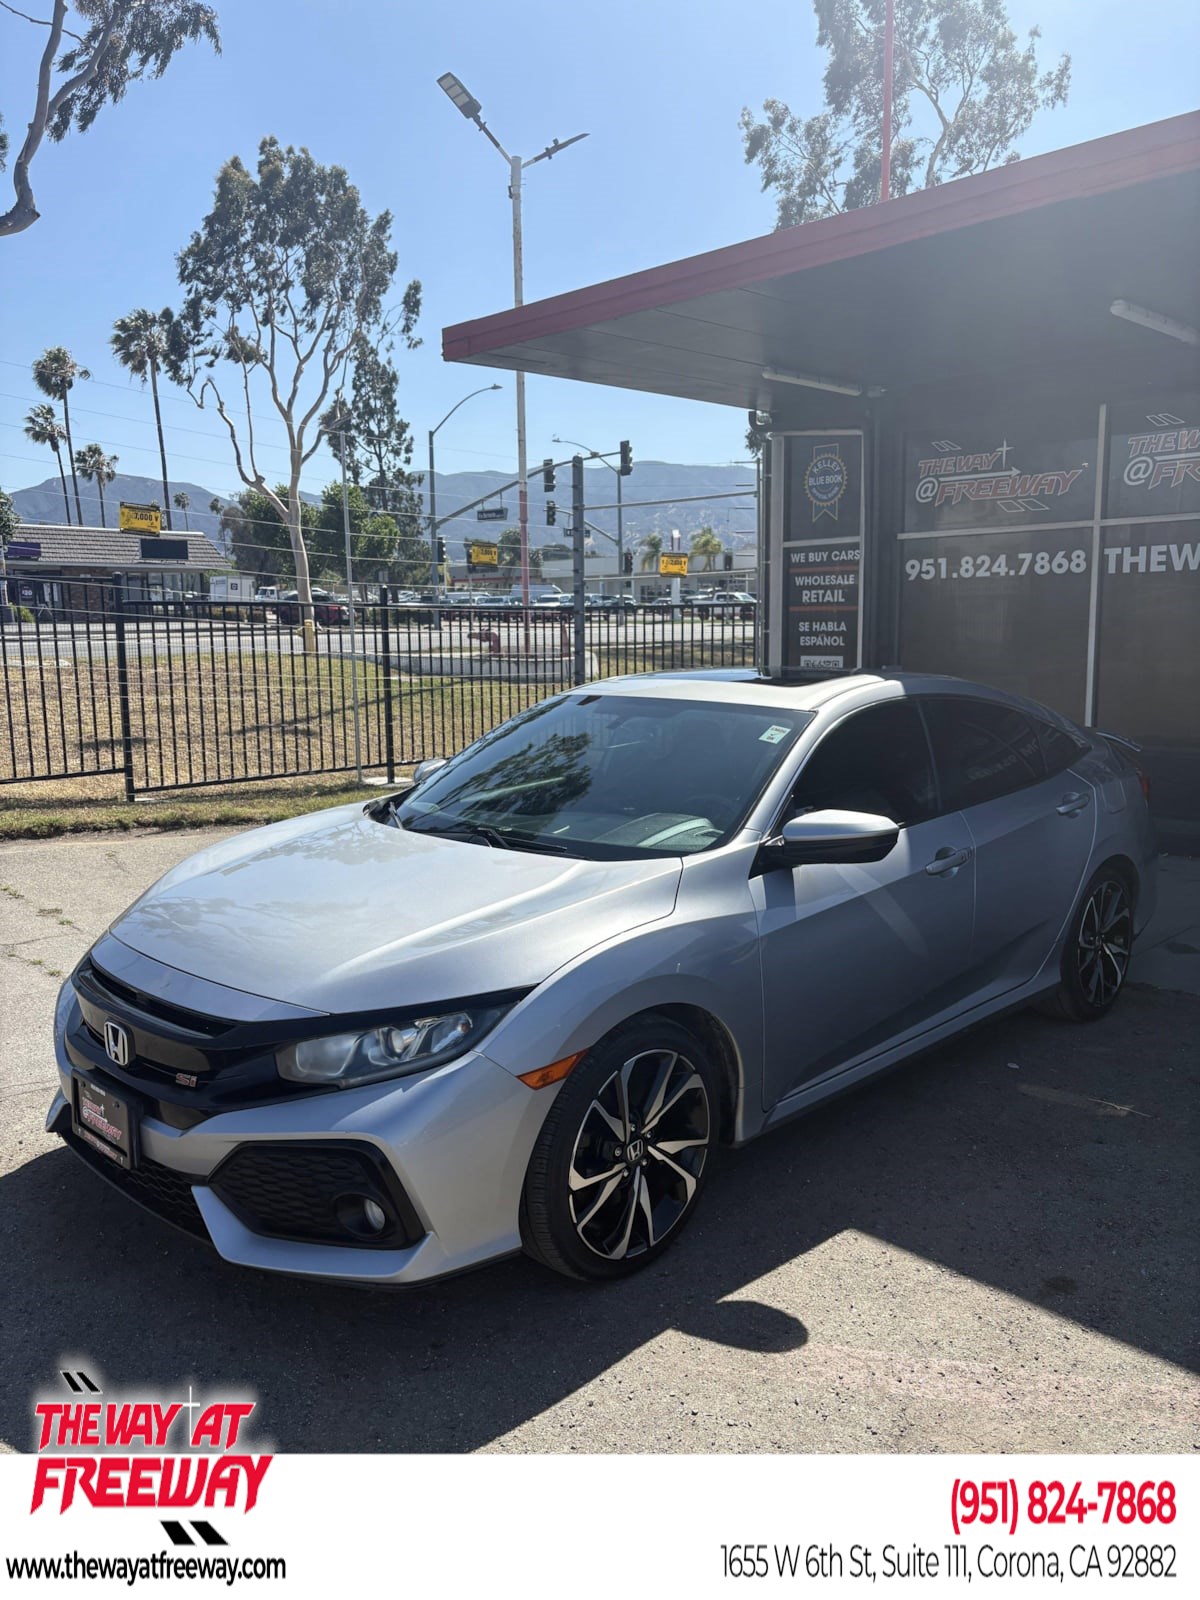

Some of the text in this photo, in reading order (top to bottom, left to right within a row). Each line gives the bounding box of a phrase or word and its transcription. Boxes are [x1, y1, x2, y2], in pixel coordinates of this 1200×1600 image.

[812, 459, 841, 474] KELLEY
[918, 452, 1002, 478] THE WAY
[808, 474, 843, 487] BLUE BOOK
[791, 549, 861, 563] WE BUY CARS
[905, 549, 1087, 580] 951.824.7868
[795, 574, 855, 586] WHOLESALE
[802, 589, 846, 603] RETAIL
[799, 621, 848, 632] SE HABLA
